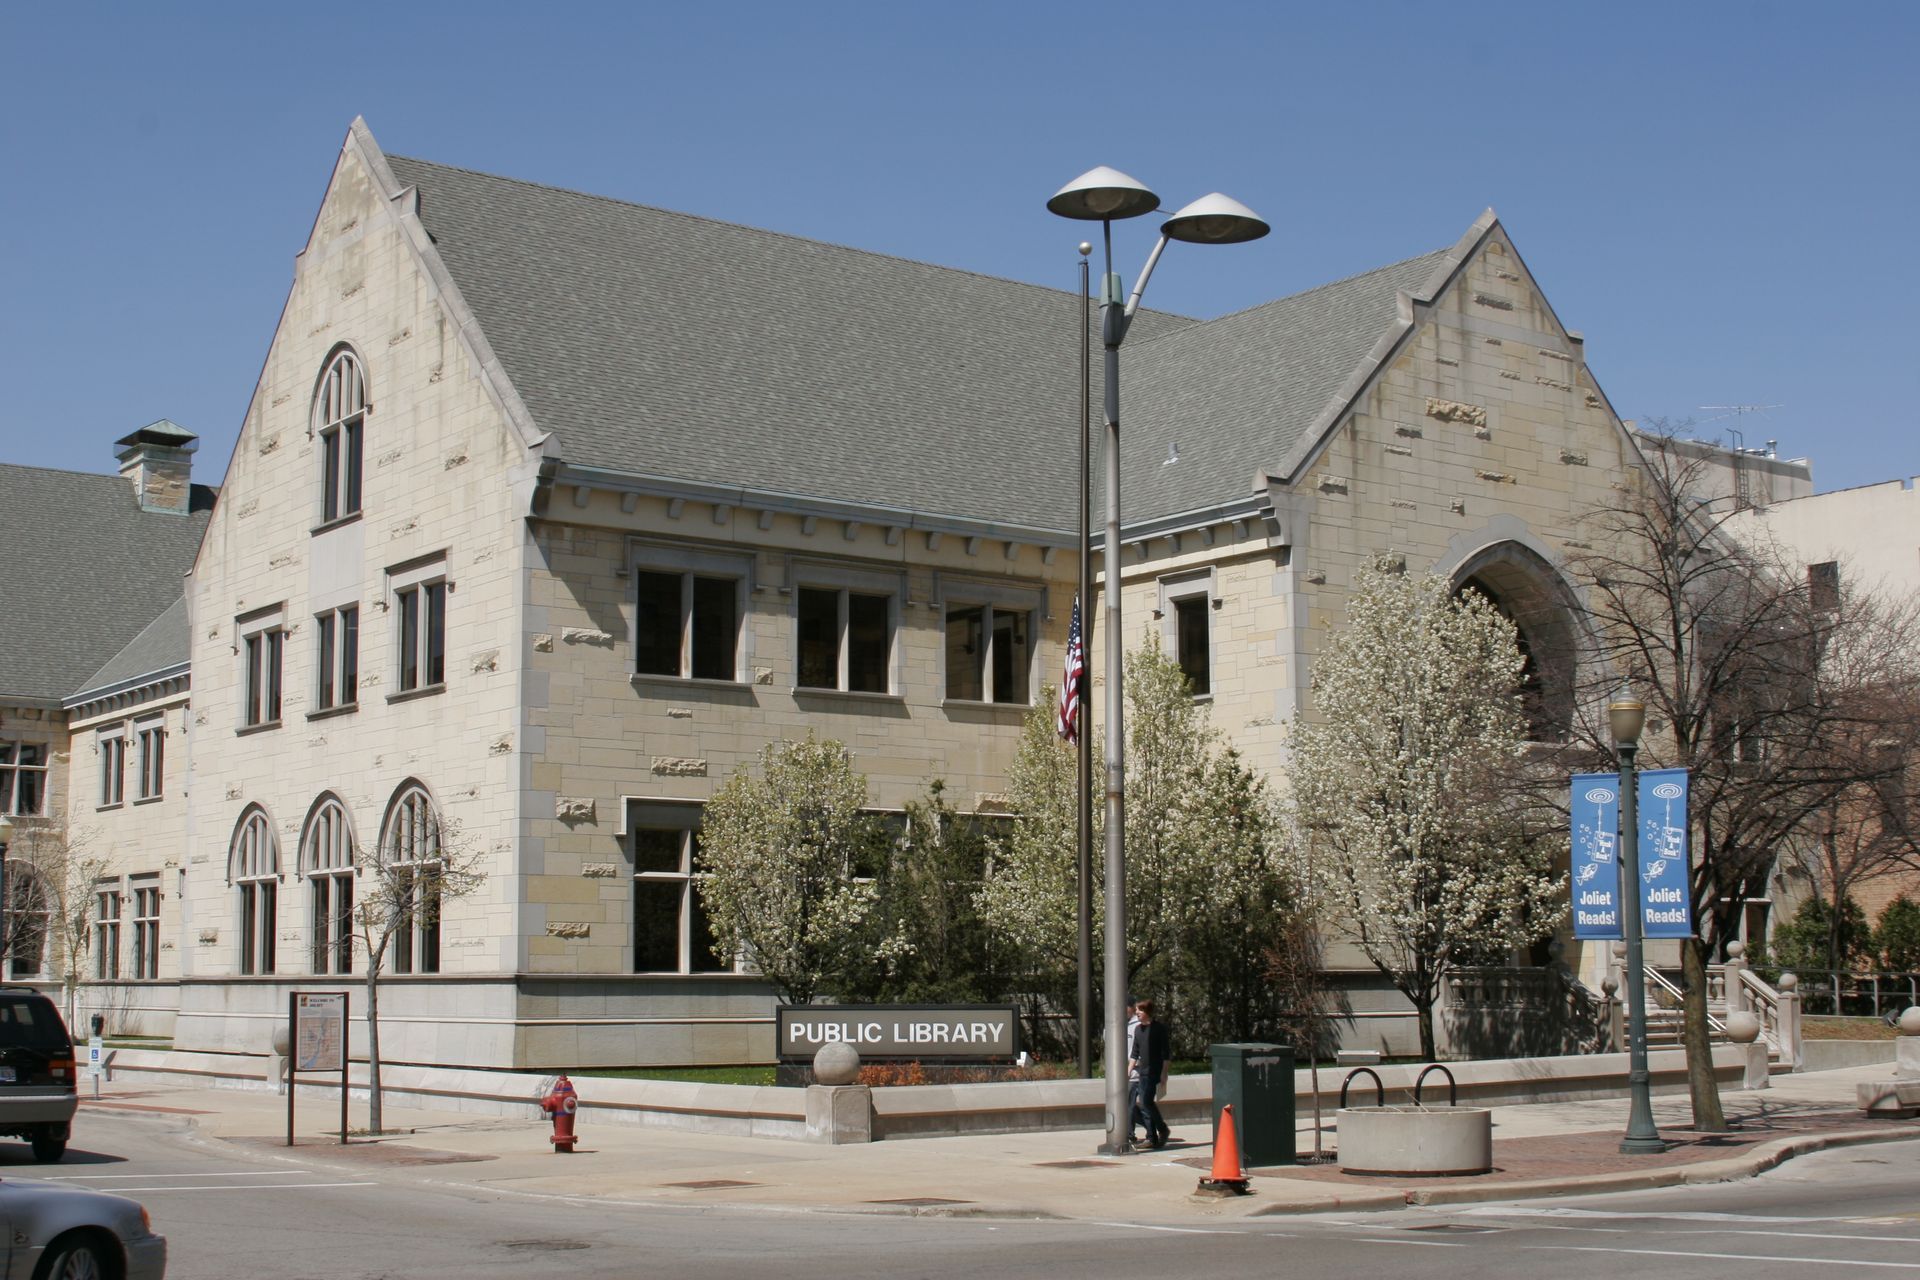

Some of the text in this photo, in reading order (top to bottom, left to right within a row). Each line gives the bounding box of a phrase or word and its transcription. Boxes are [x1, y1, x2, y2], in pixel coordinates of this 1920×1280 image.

[1579, 891, 1611, 905] Joliet
[1647, 888, 1681, 903] Joliet
[1578, 910, 1616, 925] Reads!
[1645, 908, 1686, 924] Reads!
[789, 1022, 1004, 1043] PUBLIC LIBRARY
